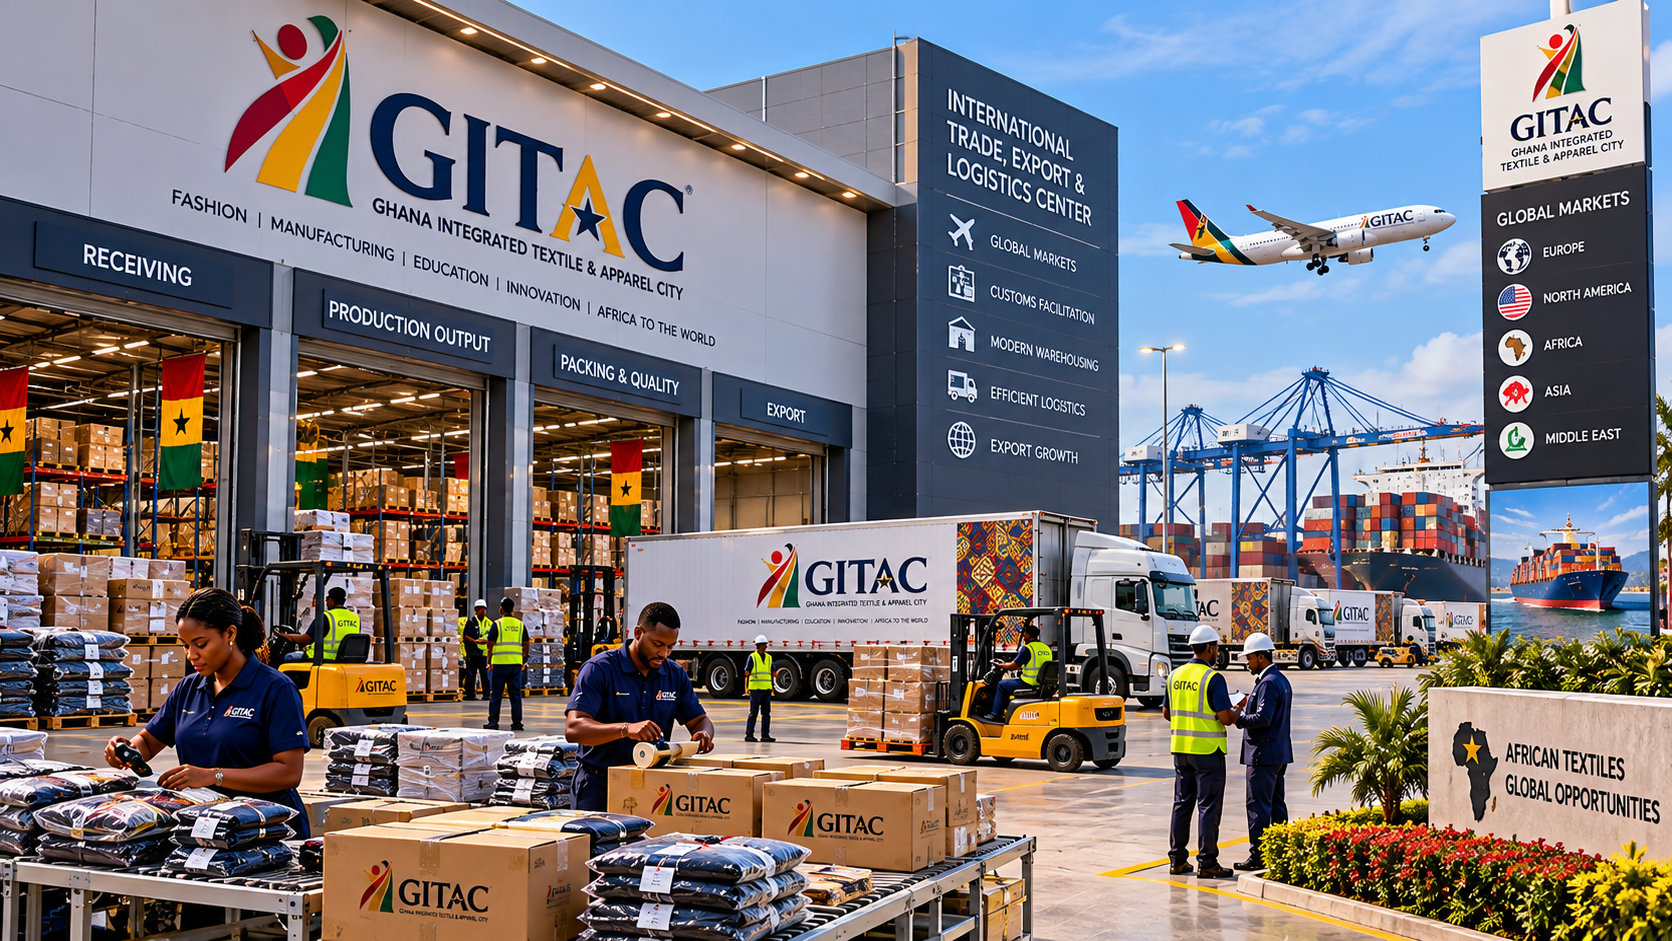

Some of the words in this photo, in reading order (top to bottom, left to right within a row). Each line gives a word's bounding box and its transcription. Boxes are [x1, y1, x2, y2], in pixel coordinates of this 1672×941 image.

[948, 88, 1074, 161] INTERNATIONAL
[1510, 97, 1613, 142] GITAC
[947, 120, 1007, 167] TRADE,
[1012, 146, 1071, 188] EXPORT
[1075, 173, 1085, 196] &
[1500, 155, 1540, 172] TEXTILE
[1542, 153, 1551, 164] &
[1552, 145, 1599, 162] APPAREL
[1600, 140, 1625, 153] CITY
[1511, 143, 1547, 157] GHANA
[1550, 130, 1613, 152] INTEGRATED
[370, 92, 684, 272] GITAC
[947, 153, 1032, 204] LOGISTICS
[1036, 187, 1092, 226] CENTER
[1370, 210, 1413, 227] GITAC
[1497, 204, 1554, 227] GLOBAL
[1558, 191, 1630, 218] MARKETS
[83, 244, 193, 287] RECEIVING
[372, 197, 432, 229] GHANA
[437, 217, 527, 255] INTEGRATED
[532, 244, 583, 273] TEXTILE
[587, 261, 597, 276] &
[600, 265, 653, 293] APPAREL
[657, 281, 683, 300] CITY
[990, 234, 1031, 259] GLOBAL
[1033, 247, 1077, 273] MARKETS
[1543, 241, 1584, 258] EUROPE
[171, 188, 247, 223] FASHION
[270, 217, 395, 262] MANUFACTURING
[413, 255, 489, 287] EDUCATION
[507, 280, 581, 311] INNOVATION
[597, 305, 637, 326] AFRICA
[640, 316, 655, 331] TO
[658, 321, 677, 337] THE
[680, 328, 716, 347] WORLD
[990, 285, 1036, 310] CUSTOMS
[1039, 299, 1095, 325] FACILITATION
[1543, 289, 1580, 305] NORTH
[1584, 282, 1632, 300] AMERICA
[328, 300, 430, 343] PRODUCTION
[434, 322, 491, 353] OUTPUT
[1543, 336, 1583, 351] AFRICA
[990, 335, 1033, 357] MODERN
[1035, 347, 1099, 372] WAREHOUSING
[561, 353, 615, 382] PACKING
[618, 369, 628, 385] &
[631, 370, 679, 396] QUALITY
[1544, 384, 1571, 397] ASIA
[767, 402, 806, 424] EXPORT
[990, 386, 1038, 408] EFFICIENT
[1041, 400, 1085, 417] LOGISTICS
[991, 439, 1032, 458] EXPORT
[1034, 445, 1078, 464] GROWTH
[1545, 430, 1589, 445] MIDDLE
[1591, 428, 1621, 443] EAST
[805, 556, 928, 595] GITAC
[1195, 599, 1219, 617] TAC
[1343, 606, 1369, 621] GITAC
[366, 680, 397, 692] GITAC
[1505, 742, 1559, 771] AFRICAN
[1562, 750, 1625, 781] TEXTILES
[675, 795, 731, 814] GITAC
[1505, 774, 1552, 802] GLOBAL
[1554, 782, 1660, 824] OPPORTUNITIES
[817, 813, 884, 836] GITAC
[398, 878, 489, 913] GITAC
